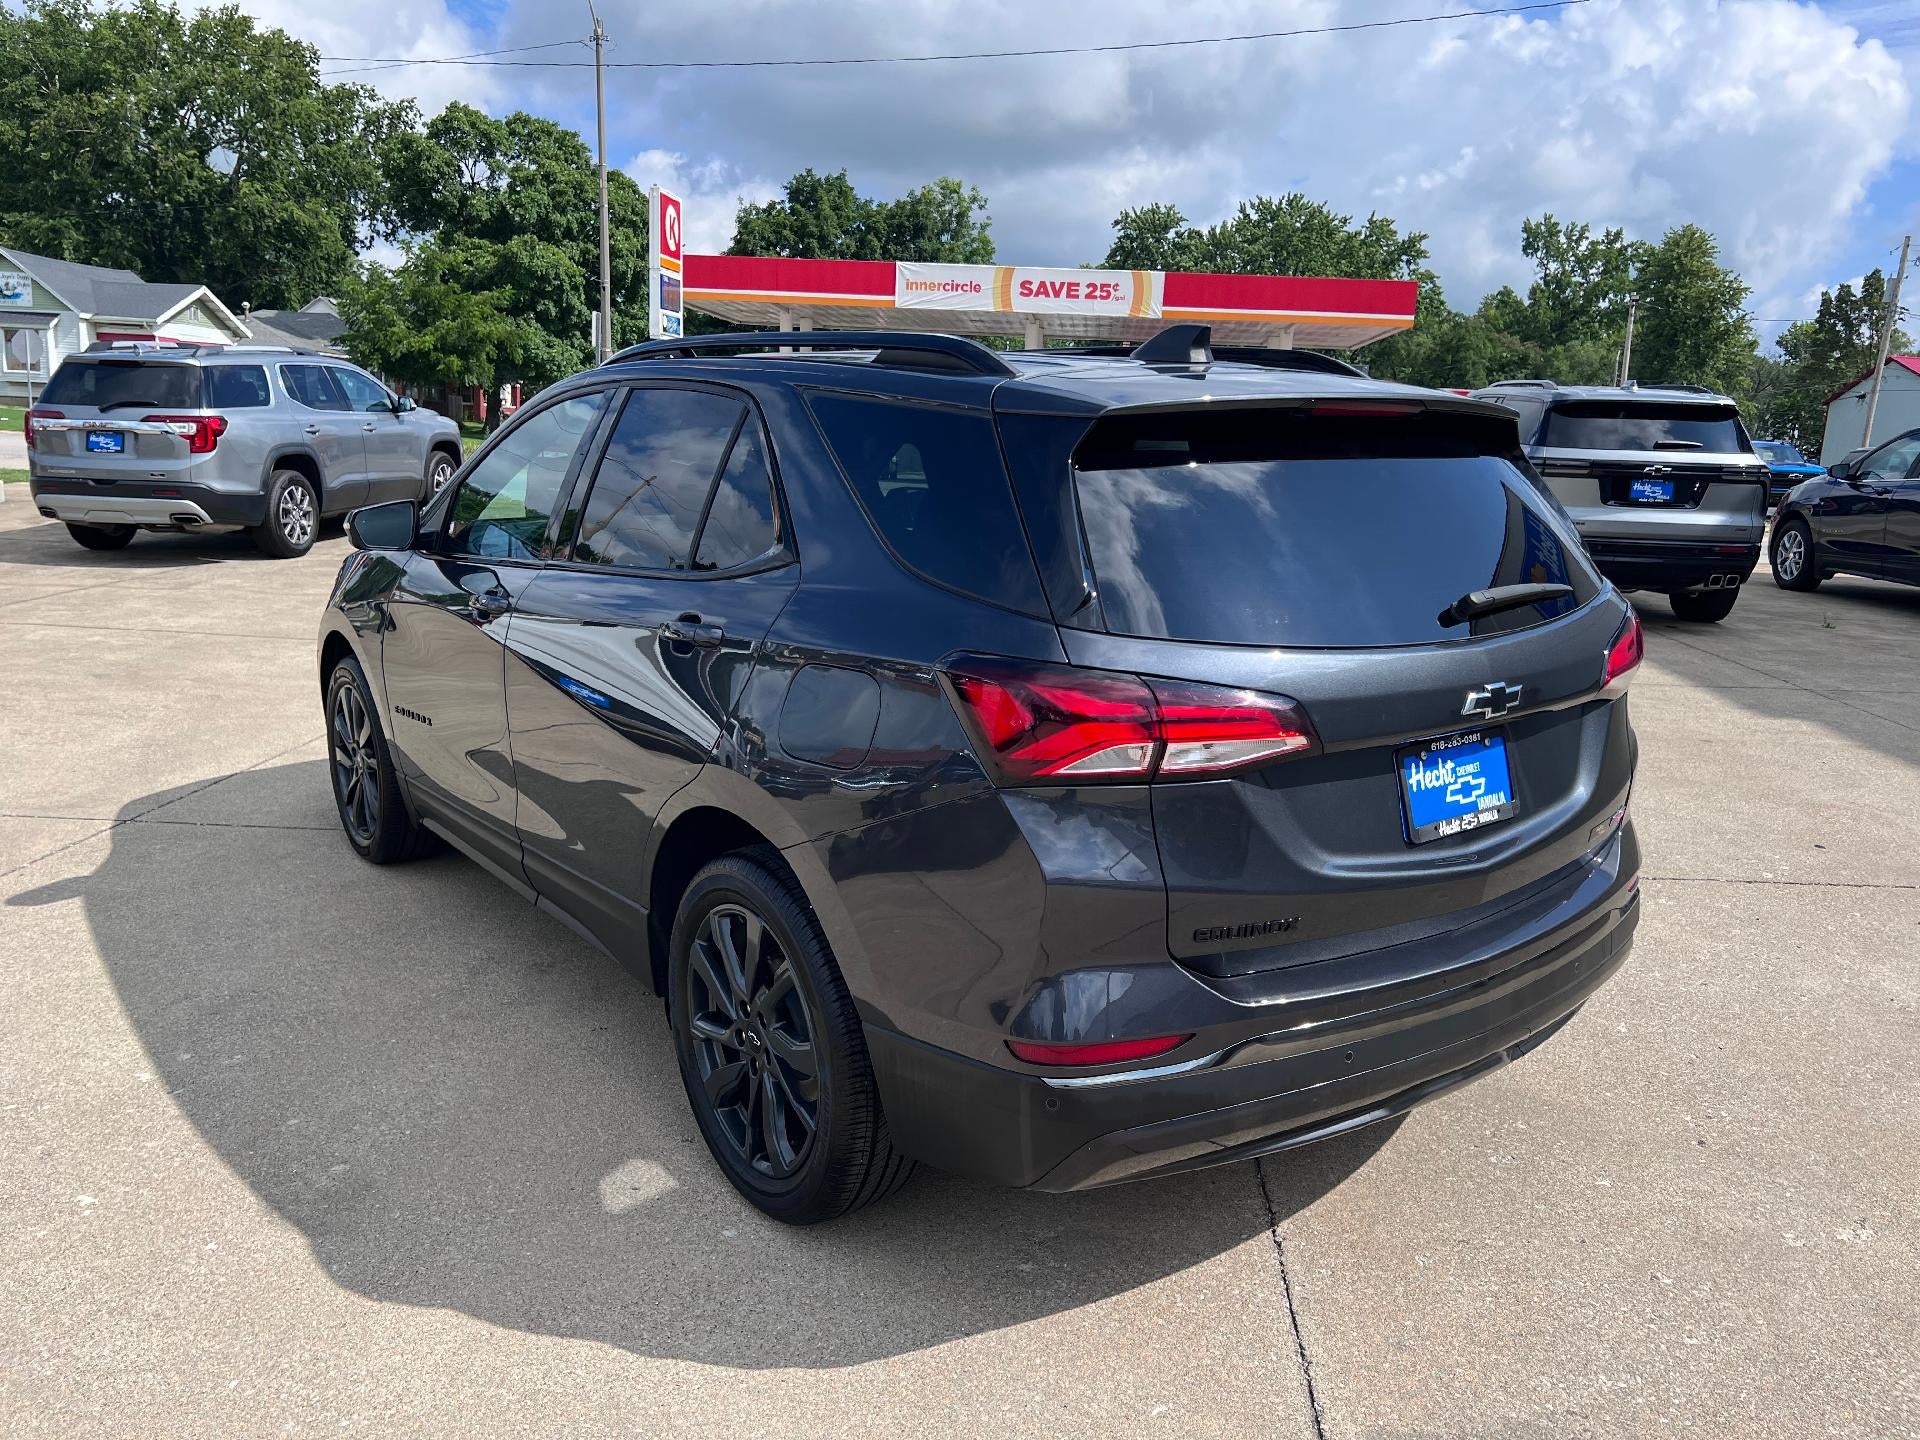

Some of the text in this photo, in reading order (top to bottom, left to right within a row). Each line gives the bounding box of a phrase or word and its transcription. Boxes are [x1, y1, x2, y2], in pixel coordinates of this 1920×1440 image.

[905, 278, 982, 293] innercircle
[1019, 280, 1080, 299] SAVE
[1409, 757, 1455, 792] Hecht
[1477, 791, 1506, 810] VANDALIA
[1193, 916, 1302, 943] EQUINOX
